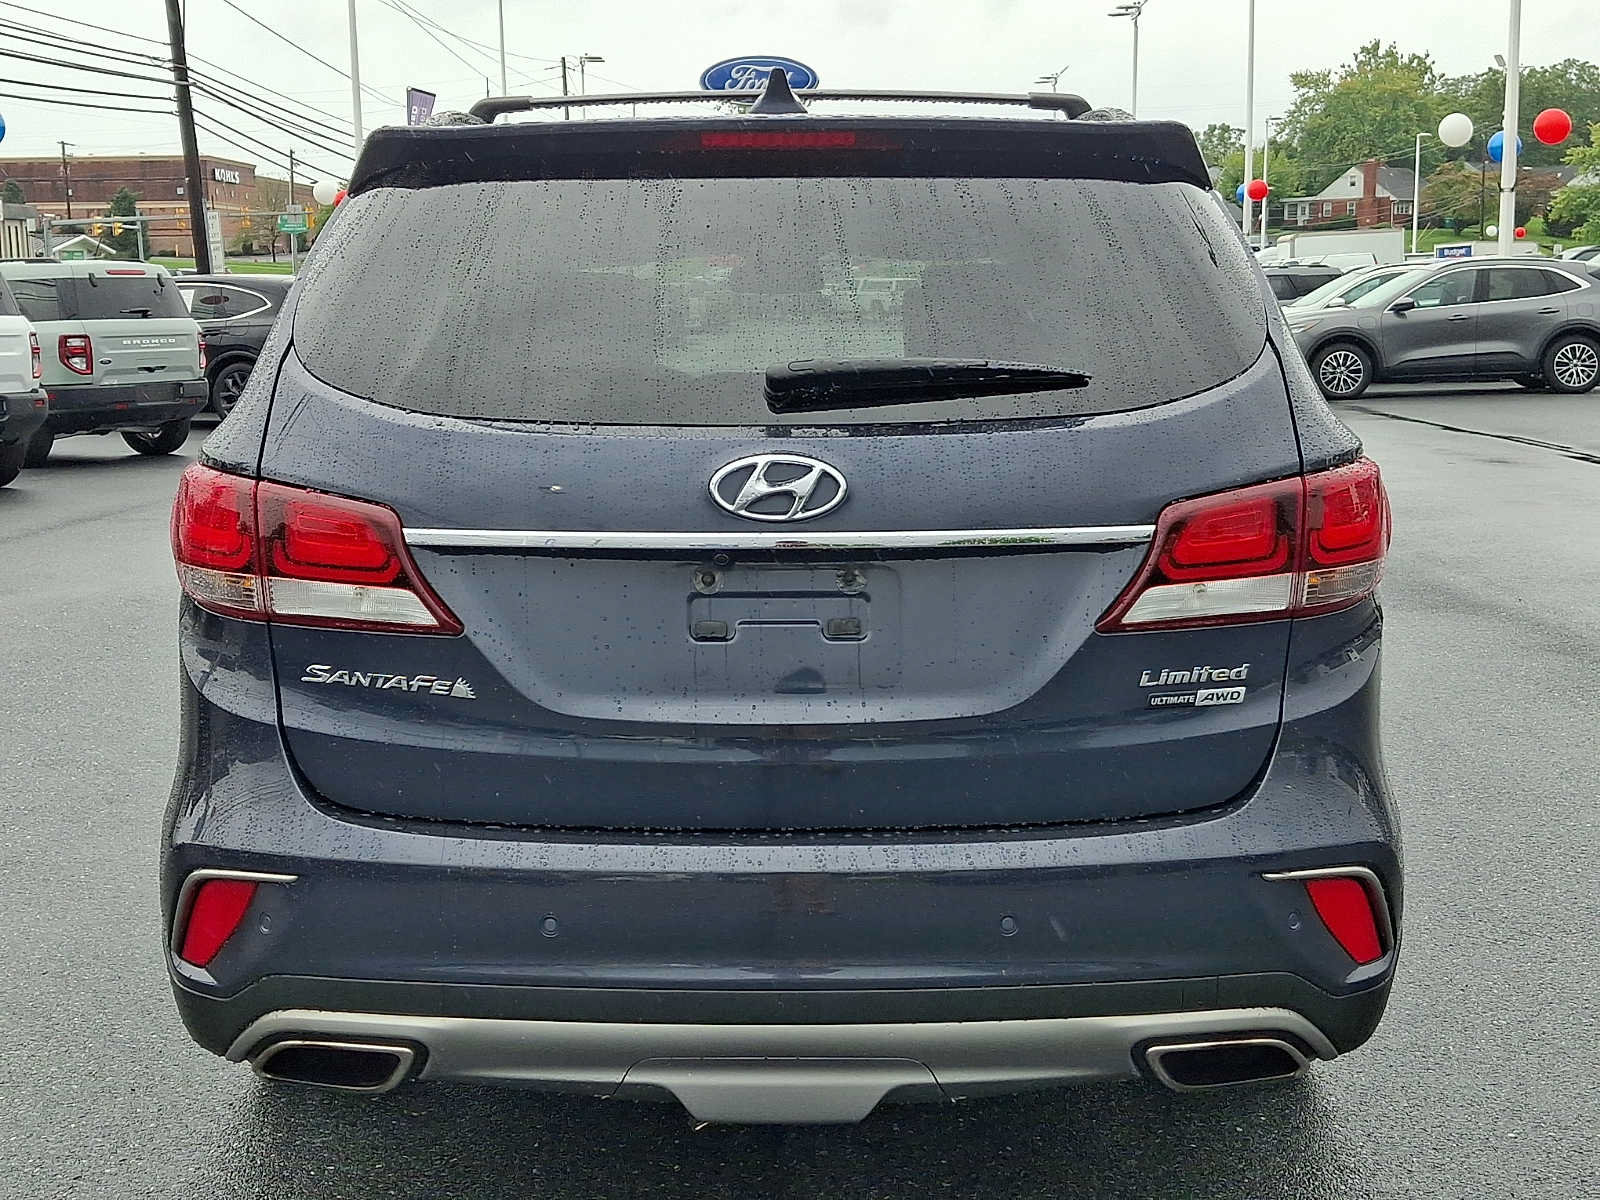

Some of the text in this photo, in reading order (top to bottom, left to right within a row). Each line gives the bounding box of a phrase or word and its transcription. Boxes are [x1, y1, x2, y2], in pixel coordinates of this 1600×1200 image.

[724, 65, 793, 90] For
[1139, 663, 1250, 686] Limited
[1150, 690, 1241, 706] ULTIMATE AWD
